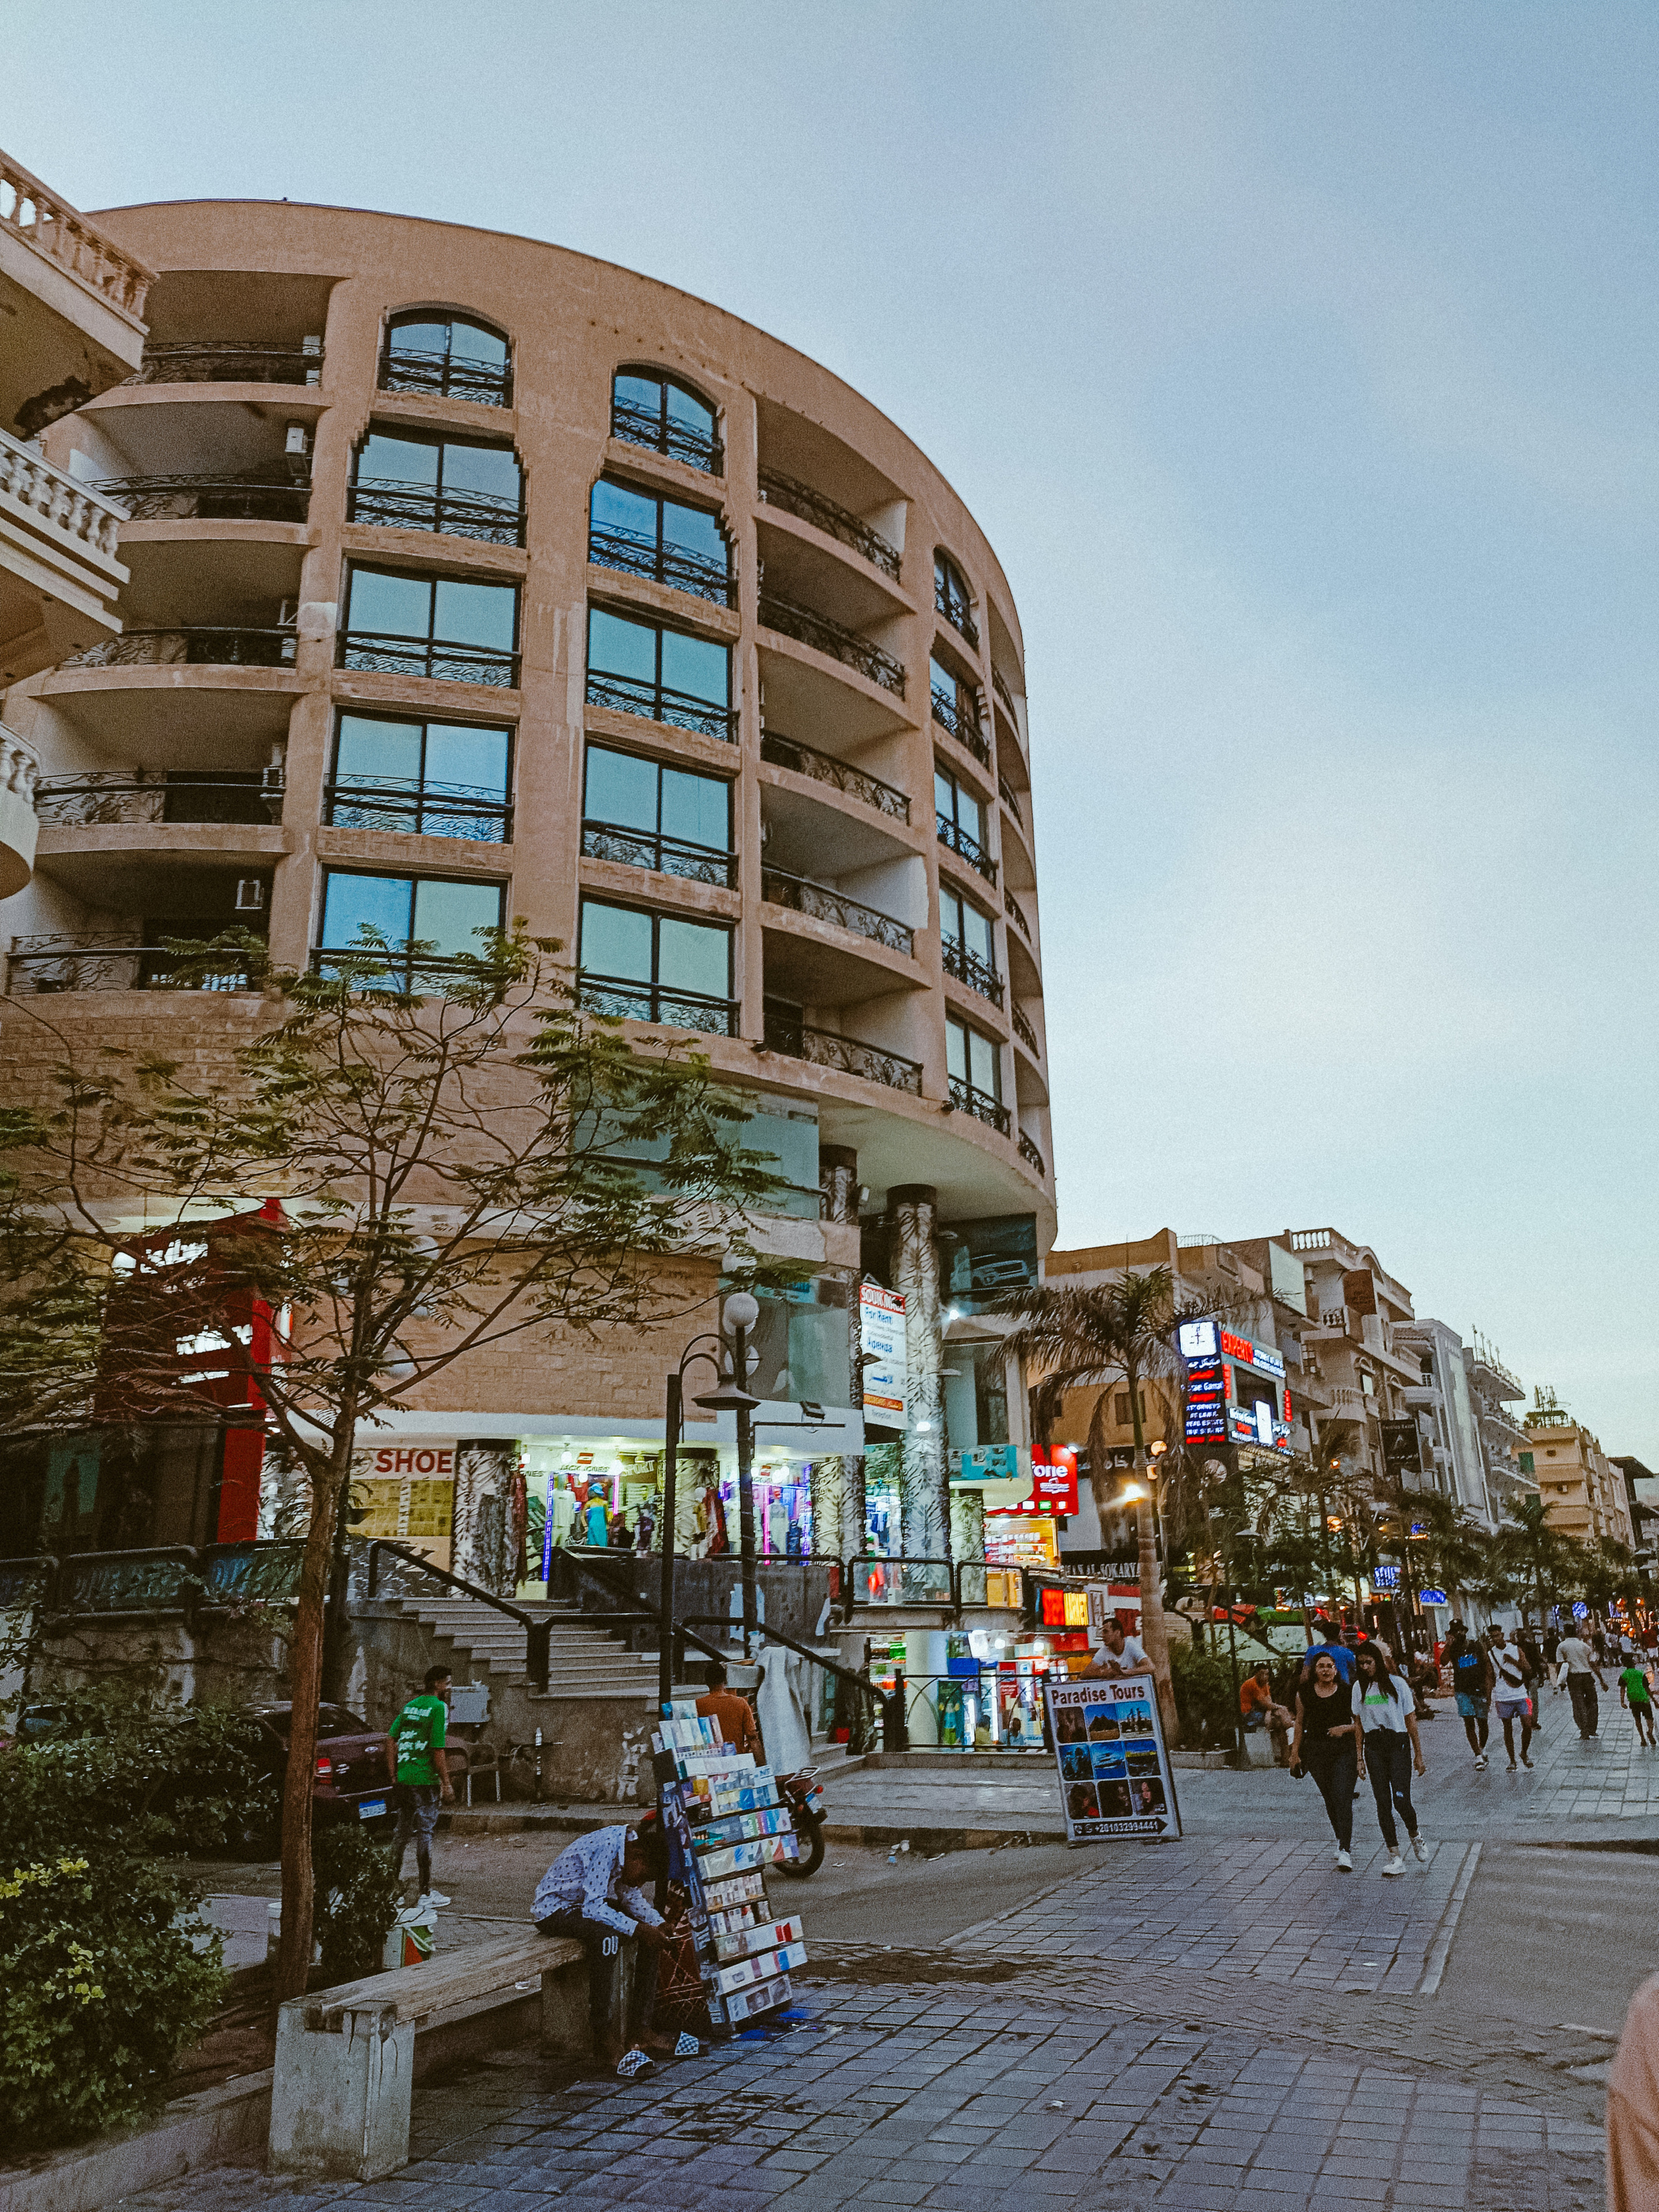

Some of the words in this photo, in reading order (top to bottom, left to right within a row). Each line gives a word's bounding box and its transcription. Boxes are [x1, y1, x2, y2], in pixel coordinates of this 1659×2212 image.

[861, 1286, 883, 1305] SOUK
[877, 1310, 893, 1325] Rent
[1051, 1686, 1106, 1705] Paradise
[1109, 1684, 1144, 1701] Tours
